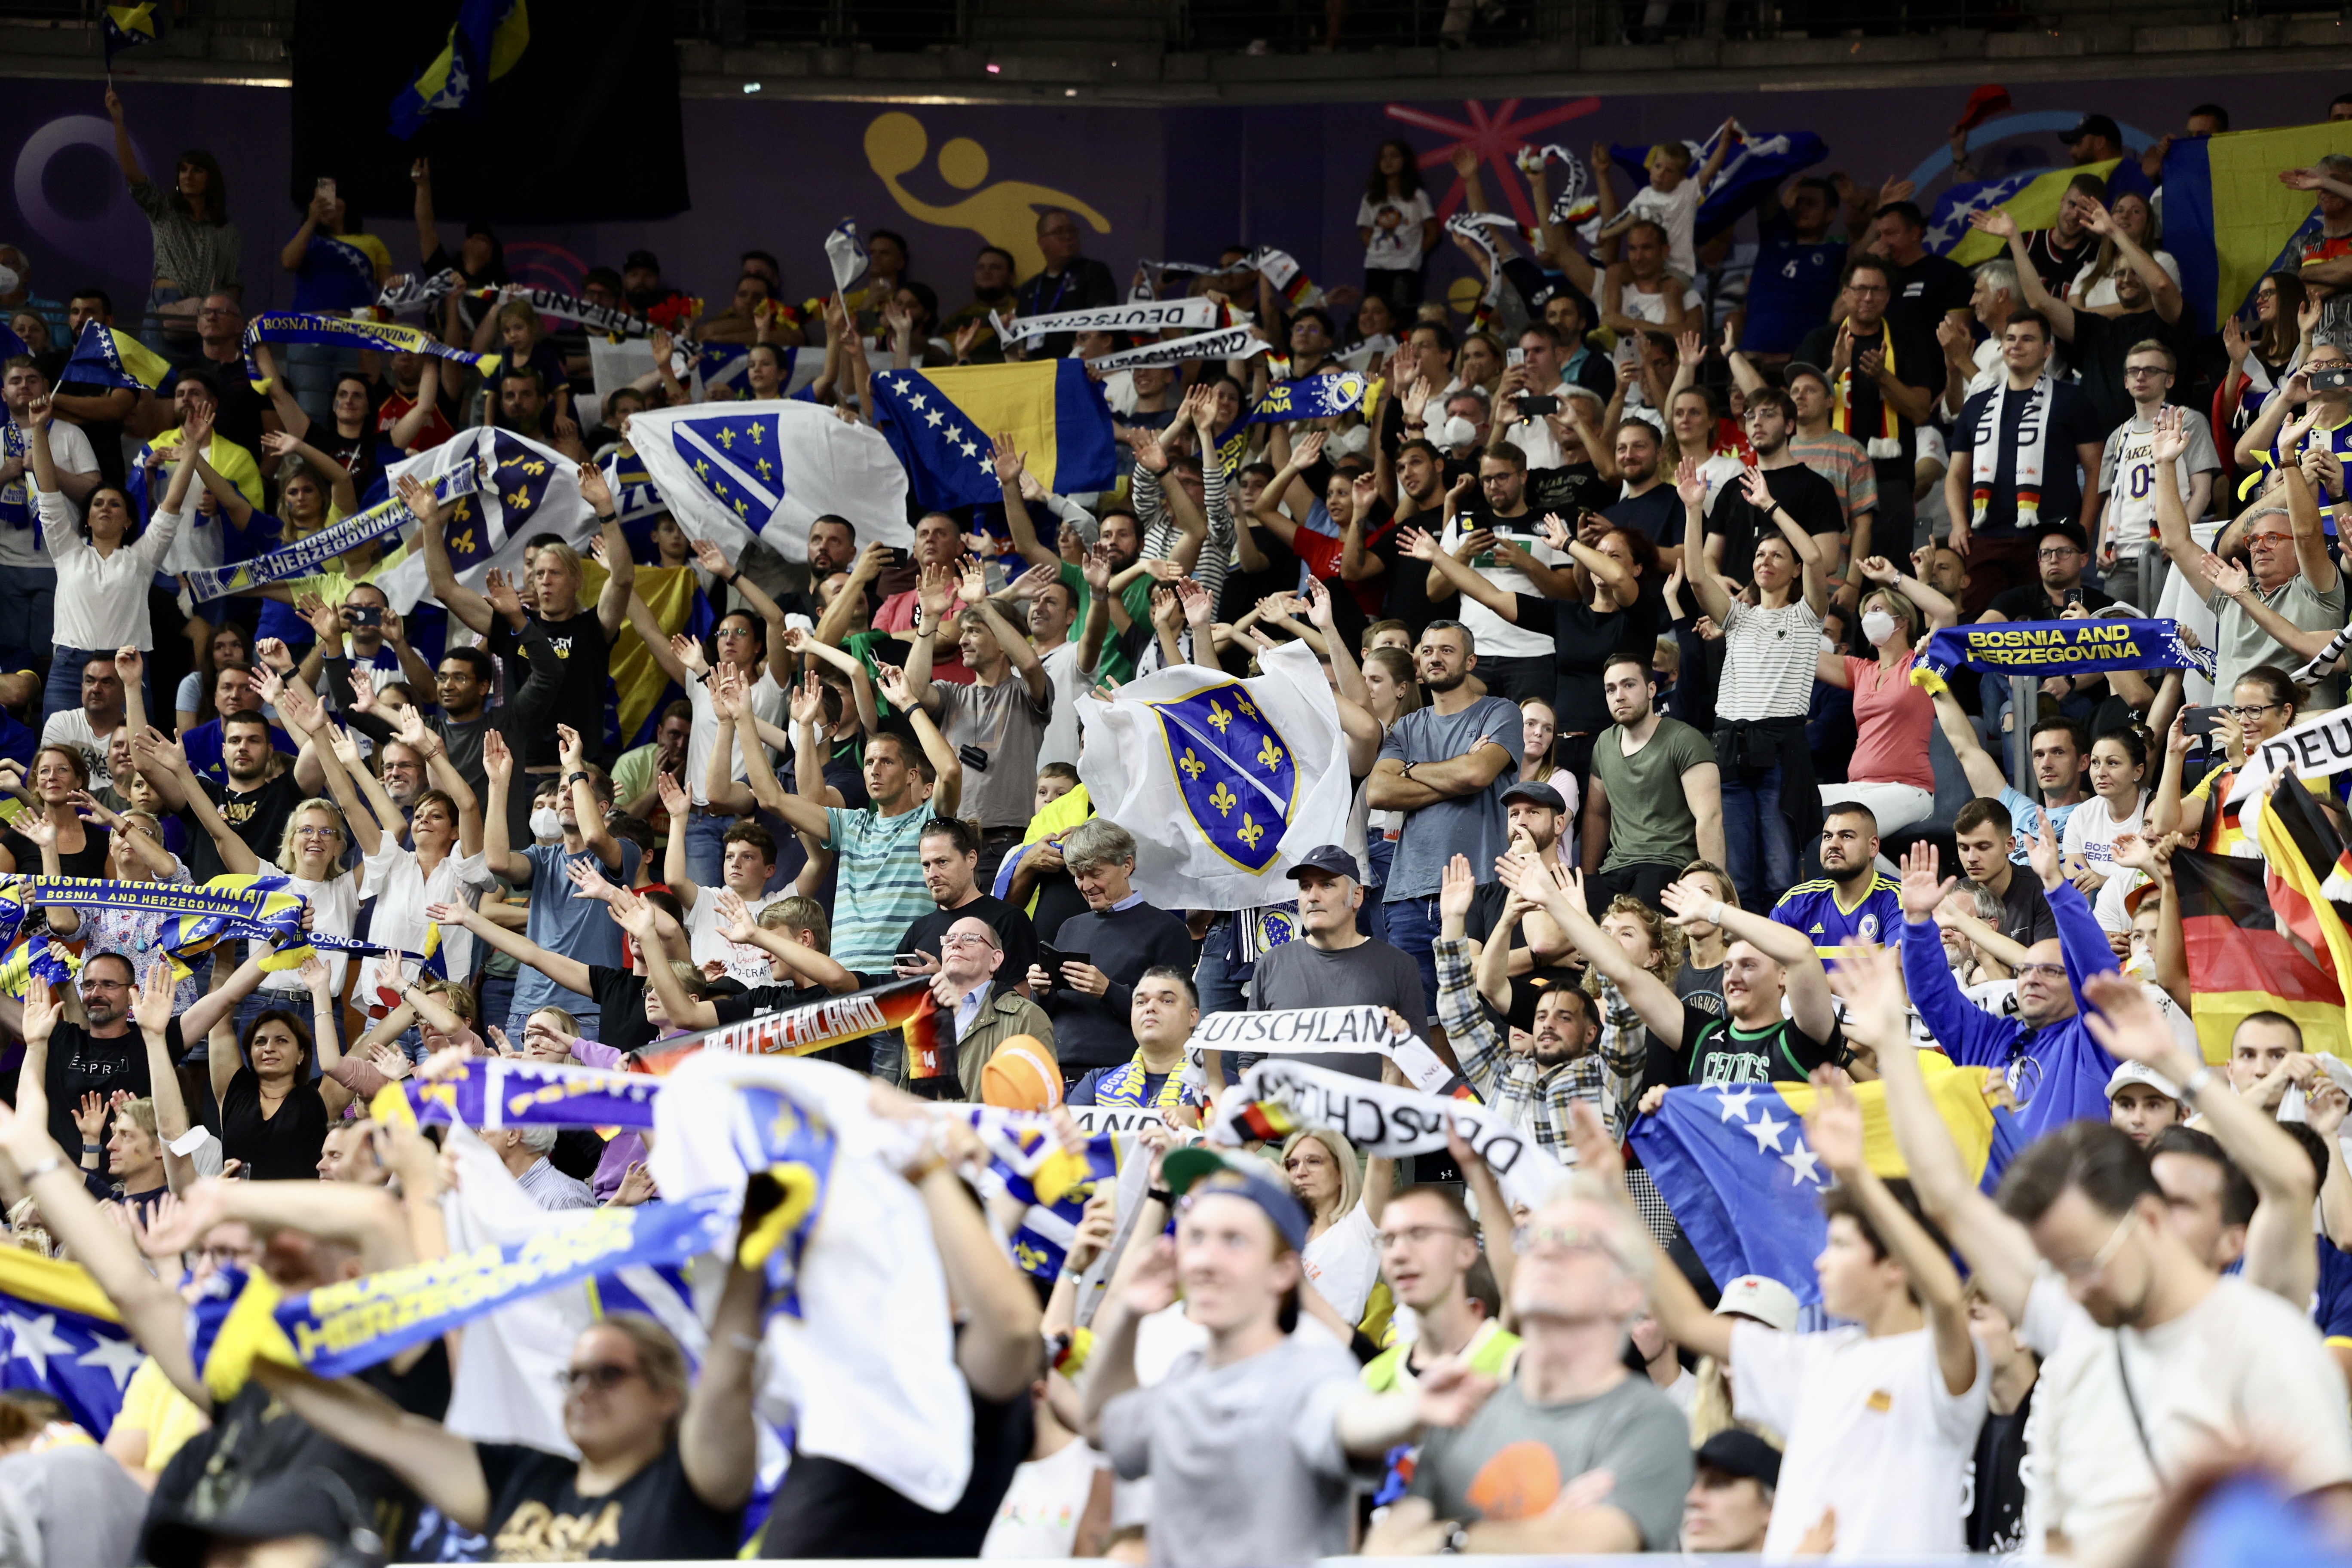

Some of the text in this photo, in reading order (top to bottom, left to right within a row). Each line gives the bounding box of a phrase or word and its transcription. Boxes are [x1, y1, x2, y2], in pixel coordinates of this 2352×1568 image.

[263, 316, 309, 330] BOSNA
[2131, 463, 2149, 501] 0
[271, 502, 406, 577] HERZEGOVINA
[1968, 625, 2130, 648] BOSNIA AND
[1965, 641, 2141, 665] HERZEGOVINA
[46, 890, 239, 914] BOSNIA AND HERZEGOVINA
[922, 1050, 937, 1069] 14
[1421, 1063, 1440, 1082] ING
